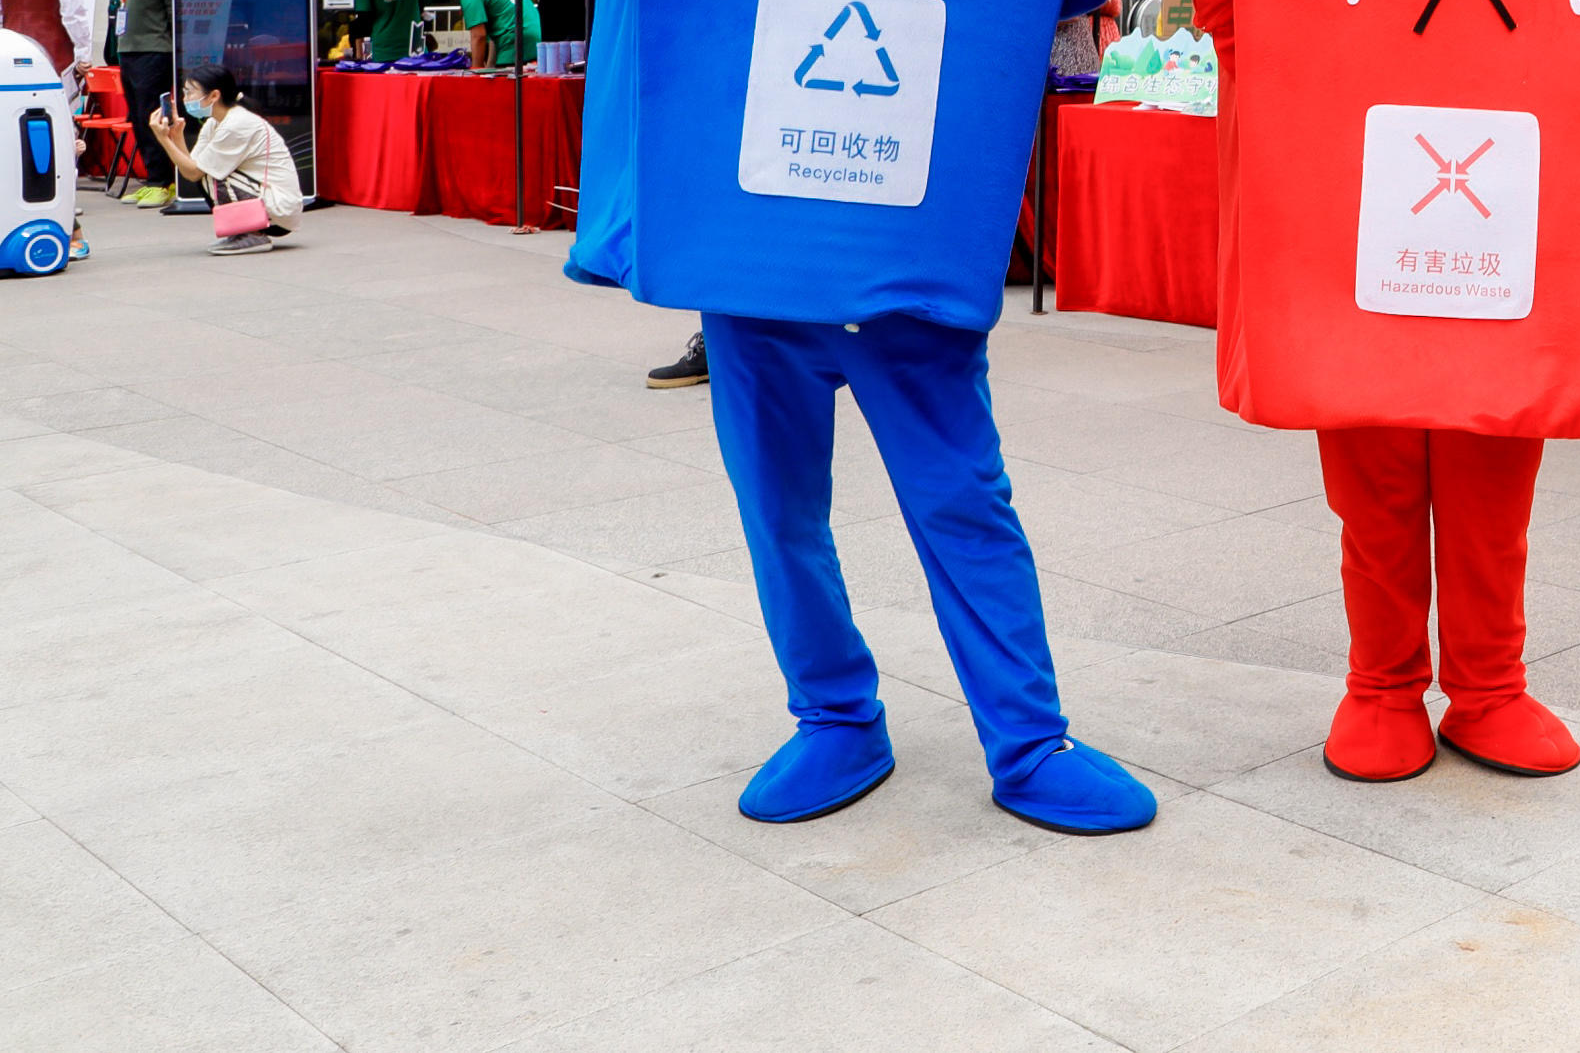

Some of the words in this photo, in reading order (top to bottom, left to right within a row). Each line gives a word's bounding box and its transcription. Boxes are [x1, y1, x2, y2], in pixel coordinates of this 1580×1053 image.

[779, 126, 900, 163] 可回收物
[788, 163, 884, 185] Recyclable
[1395, 248, 1502, 278] 有害垃圾
[1381, 278, 1461, 296] Hazardous
[1465, 282, 1511, 299] Waste
